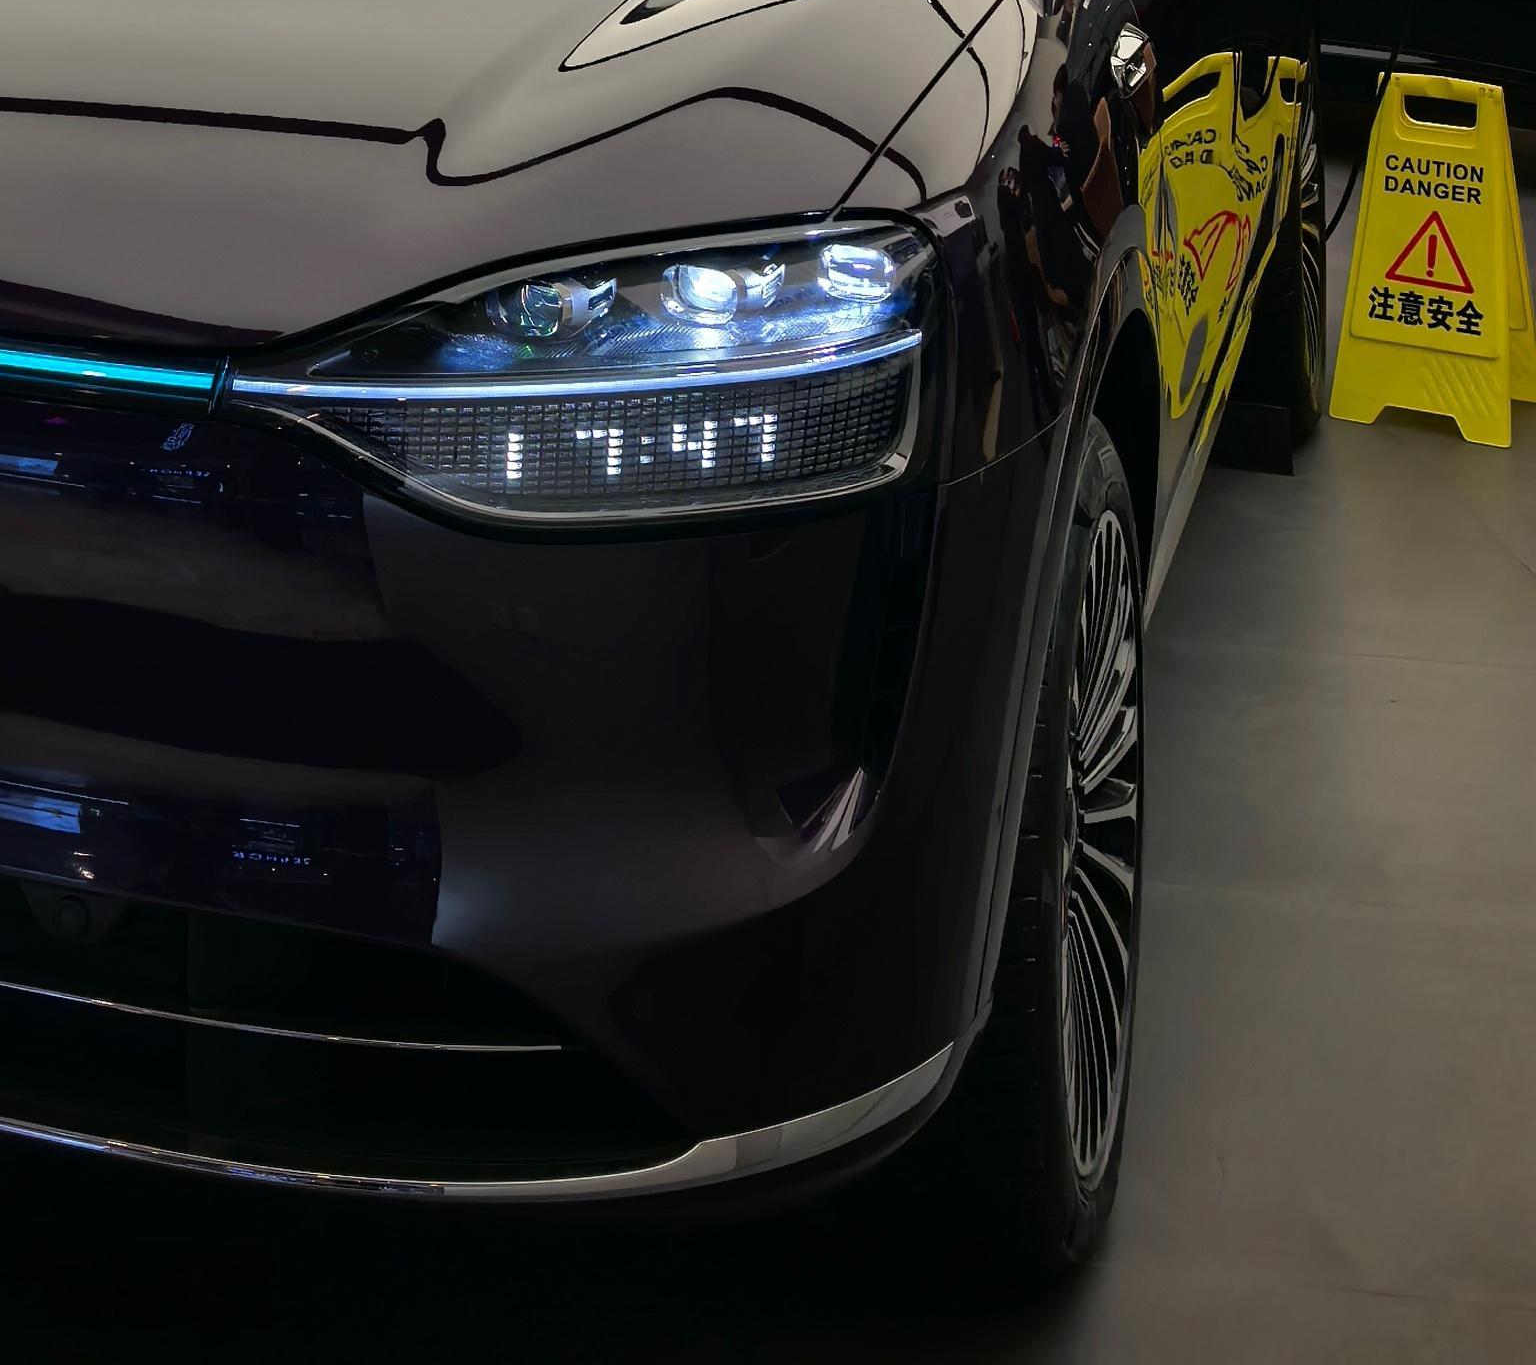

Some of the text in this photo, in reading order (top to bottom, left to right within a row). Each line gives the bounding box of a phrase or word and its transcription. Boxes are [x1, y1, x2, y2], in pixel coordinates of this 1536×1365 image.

[1385, 154, 1484, 184] CAUTION
[1384, 175, 1482, 205] DANGER
[1367, 285, 1484, 336] 注意安全
